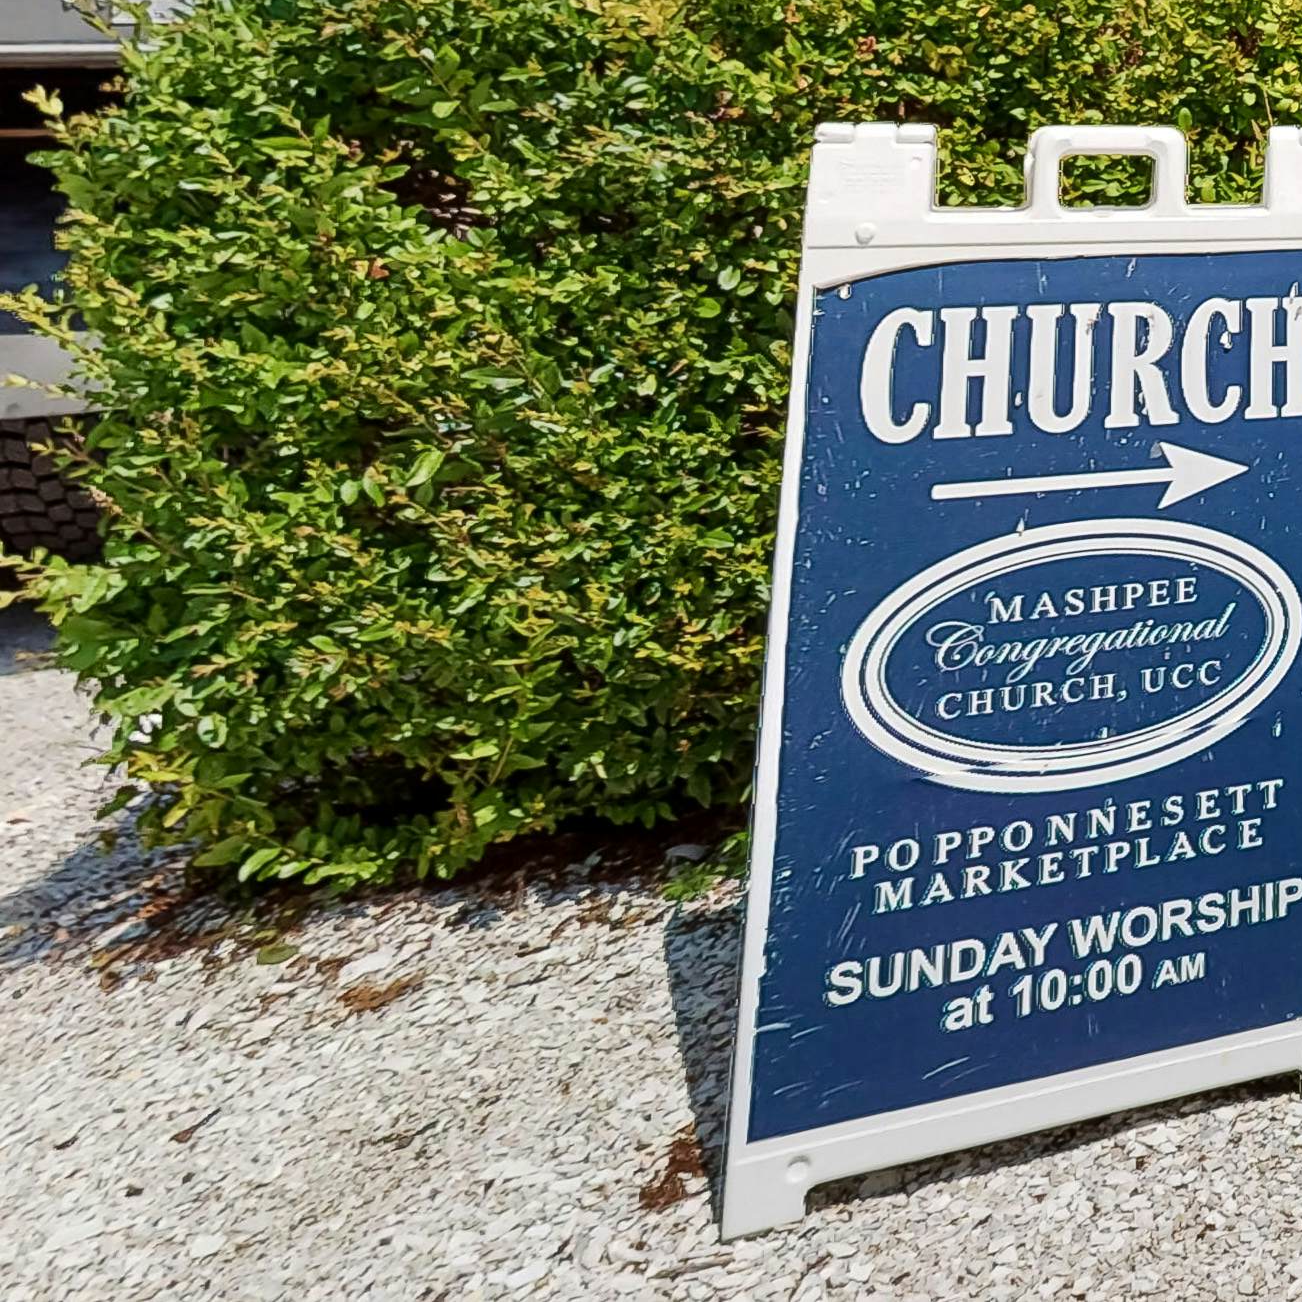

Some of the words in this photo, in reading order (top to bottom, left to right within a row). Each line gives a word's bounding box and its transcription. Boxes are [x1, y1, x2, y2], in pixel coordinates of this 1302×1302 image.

[988, 577, 1198, 624] MASHPEE
[925, 602, 1237, 683] Congregational
[936, 672, 1127, 720] CHURCH,
[1142, 659, 1222, 693] UCC
[849, 779, 1284, 880] POPPONNESETT
[872, 818, 1263, 914] MARKETPLACE
[824, 923, 1058, 1006] SUNDAY
[940, 986, 994, 1032] at
[1010, 954, 1142, 1018] 10:00
[1151, 952, 1206, 988] AM
